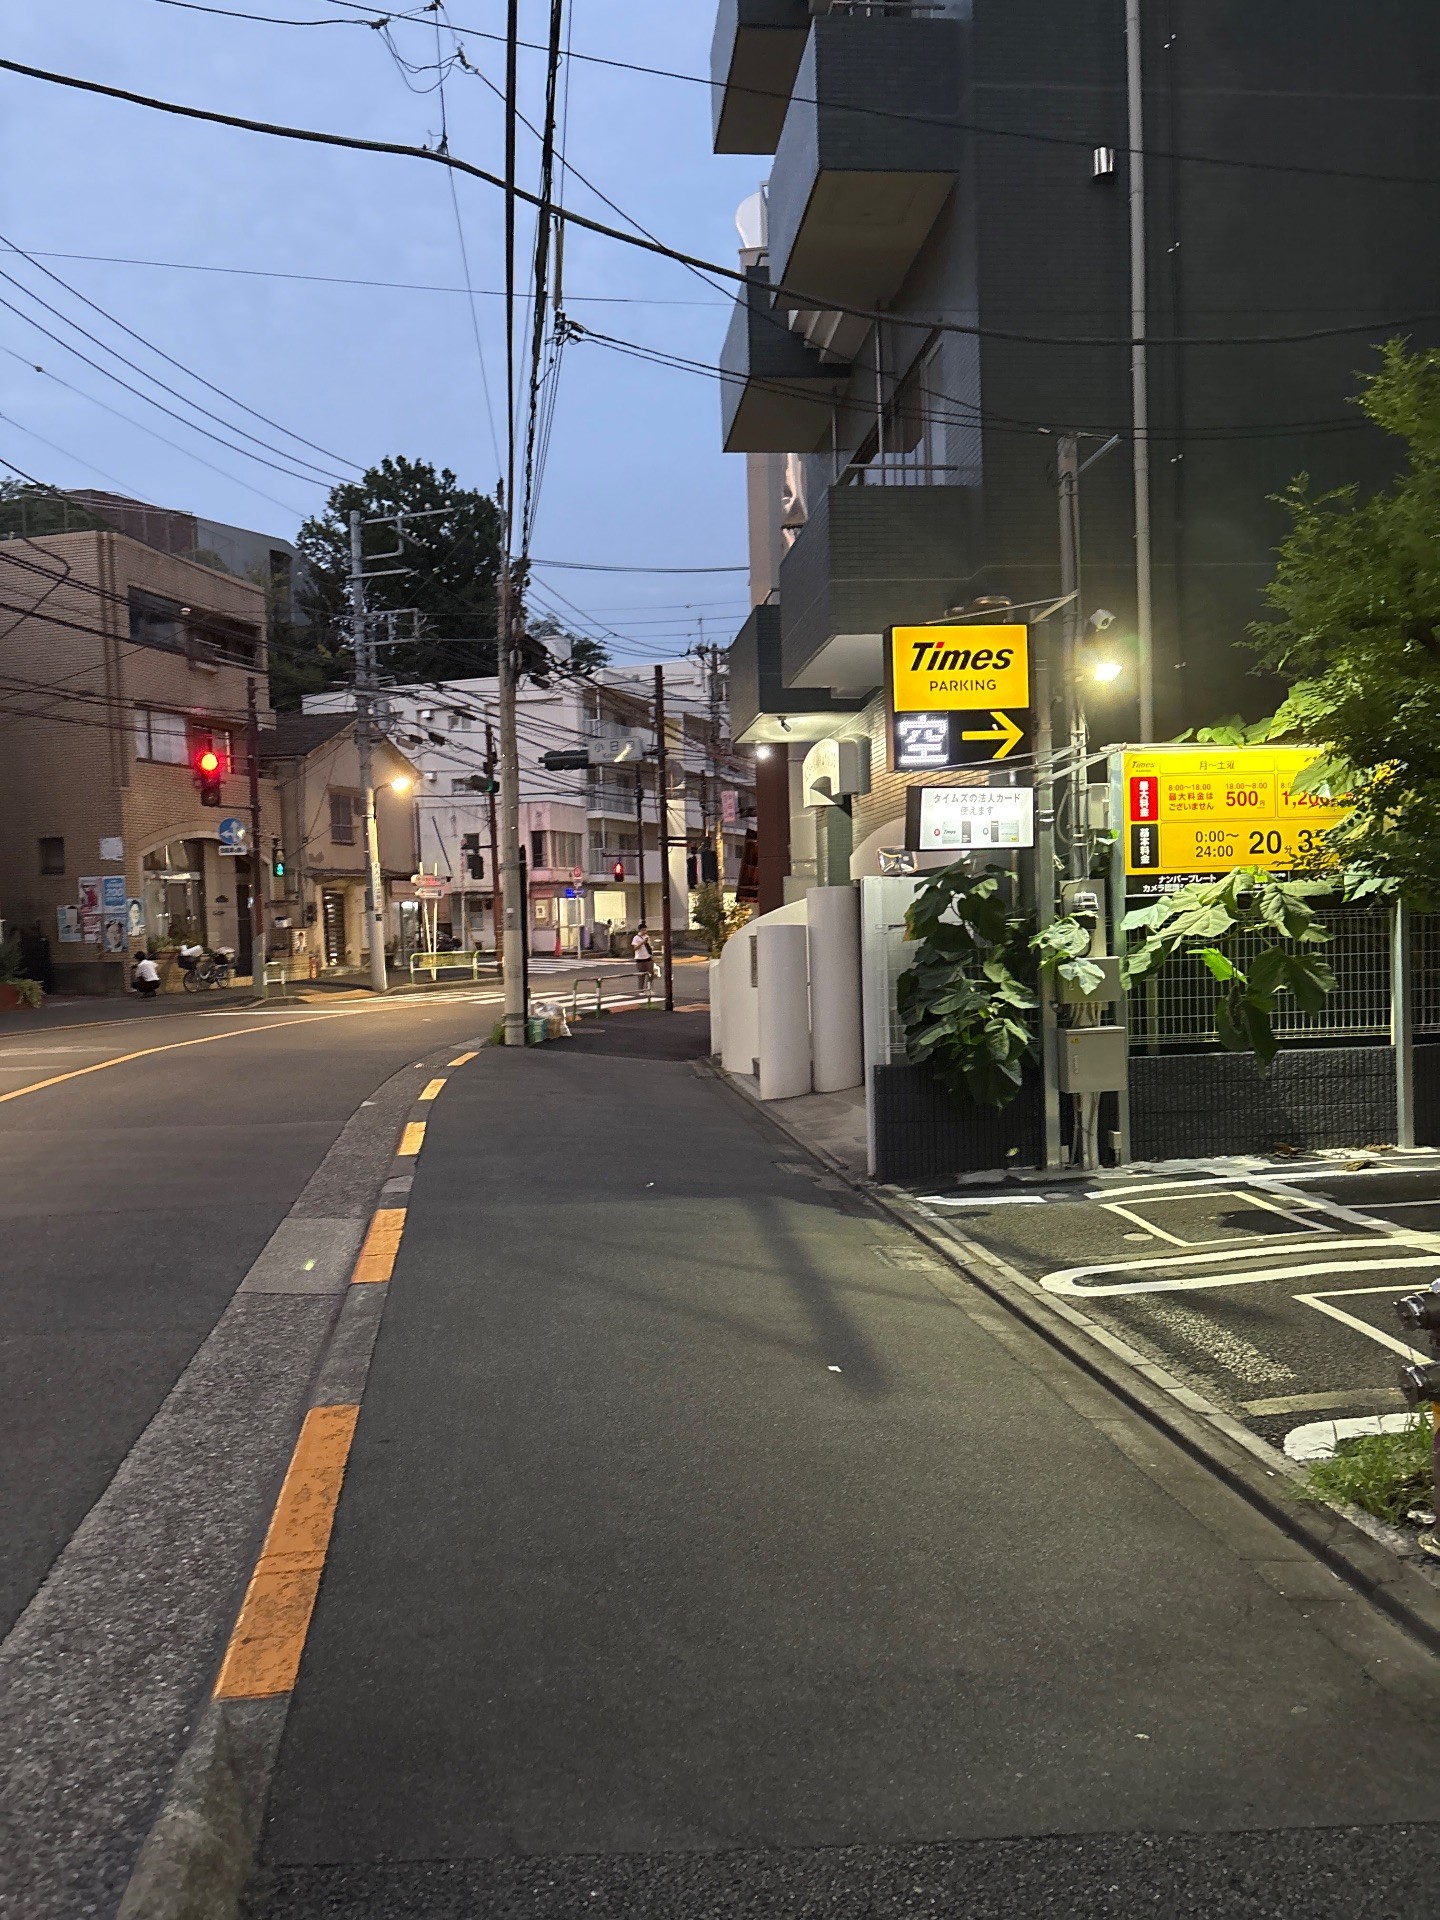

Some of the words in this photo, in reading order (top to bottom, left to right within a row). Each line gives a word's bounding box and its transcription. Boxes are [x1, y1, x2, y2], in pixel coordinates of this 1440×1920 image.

[911, 641, 1014, 671] Times
[929, 679, 997, 691] PARKING
[897, 714, 949, 764] 空
[1131, 760, 1155, 768] Times
[933, 793, 1021, 804] タイムズの法人カード
[960, 806, 994, 815] 使えます
[1168, 803, 1214, 811] ございません
[1195, 845, 1234, 858] 24:00
[1158, 874, 1216, 884] ナンバープレート
